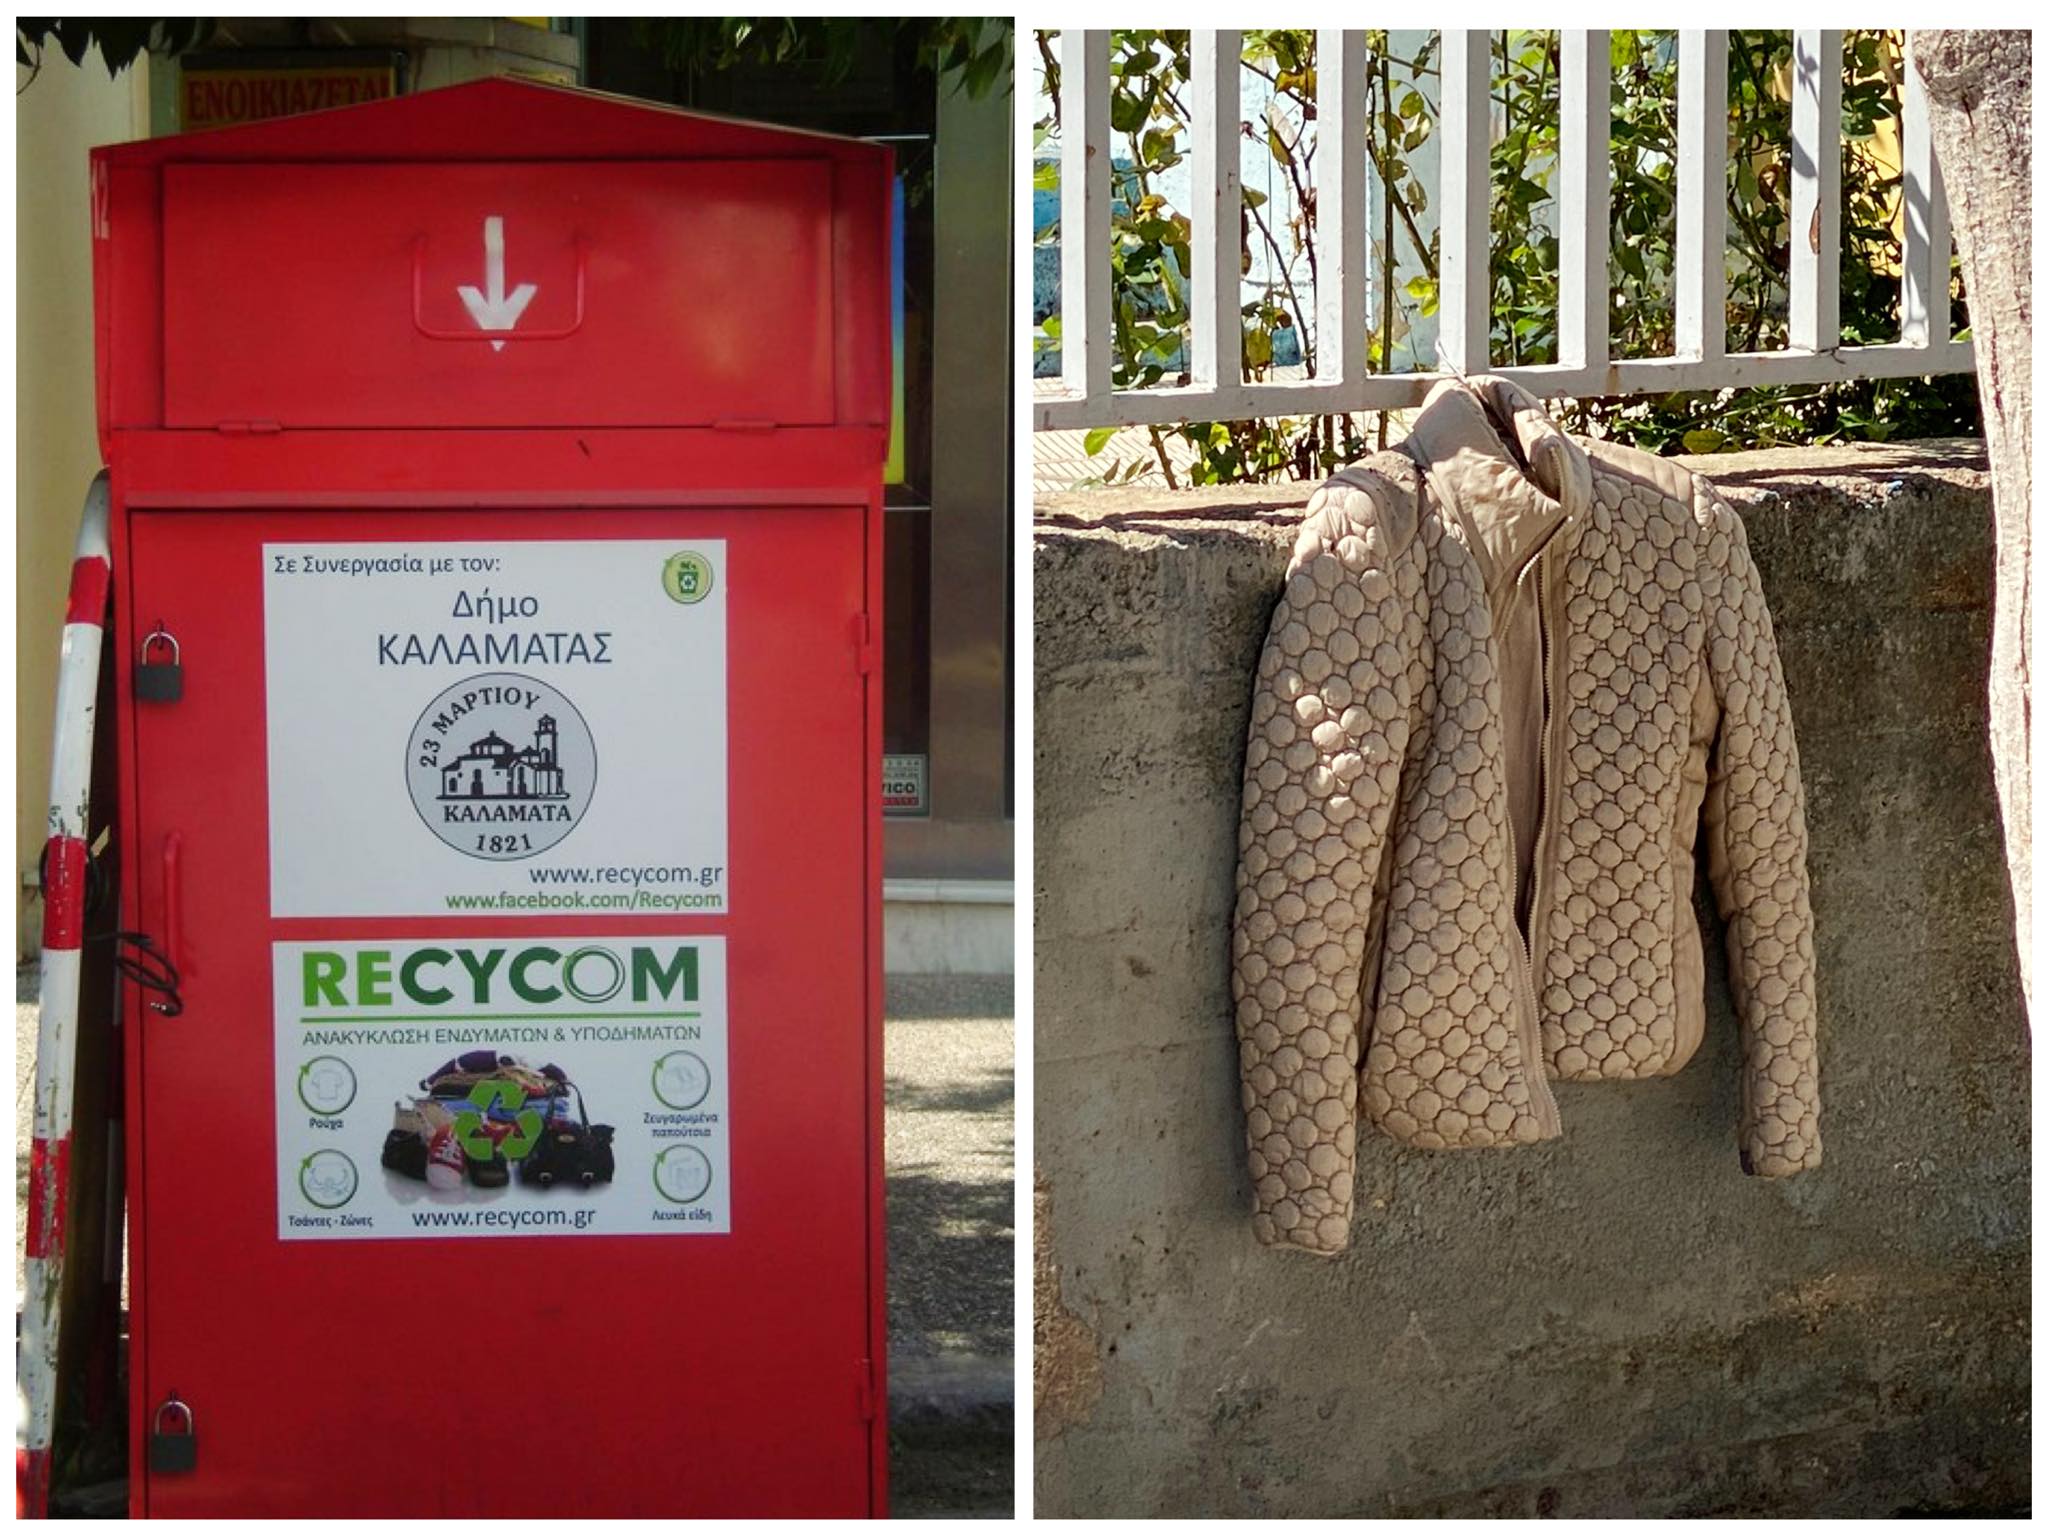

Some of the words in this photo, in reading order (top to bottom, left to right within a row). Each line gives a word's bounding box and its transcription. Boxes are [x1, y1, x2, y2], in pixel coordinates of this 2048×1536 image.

[275, 556, 296, 573] Σε
[303, 554, 423, 576] Συνεργασία
[430, 559, 453, 575] με
[460, 559, 499, 572] τον:
[453, 588, 538, 624] Δήμο
[379, 633, 612, 665] ΚΑΛΑΜΑΤΑΣ
[420, 739, 440, 767] 23
[431, 687, 541, 735] ΜΑΡΤΙΟΥ
[444, 805, 571, 822] ΚΑΛΑΜΑΤΑ
[477, 834, 532, 853] 1821
[530, 866, 722, 887] www.recycom.gr
[446, 890, 722, 910] www.facebook.com/Recycom
[302, 945, 699, 1006] RECYCOM
[303, 1029, 429, 1045] ΑΝΑΚΥΚΛΩΣΗ
[436, 1028, 548, 1043] ΕΝΔΥΜΑΤΩΝ
[554, 1027, 565, 1041] &
[571, 1026, 700, 1041] ΥΠΟΔΗΜΑΤΩΝ
[310, 1117, 343, 1130] Ρούχα
[644, 1112, 718, 1125] Ζευγαρωμένα
[652, 1126, 711, 1137] παπούτσια
[288, 1216, 331, 1228] Τσάντες
[341, 1214, 373, 1227] Ζώνες
[411, 1210, 597, 1230] www.recycom.gr
[653, 1210, 685, 1220] Λευκά
[689, 1209, 712, 1222] είδη
